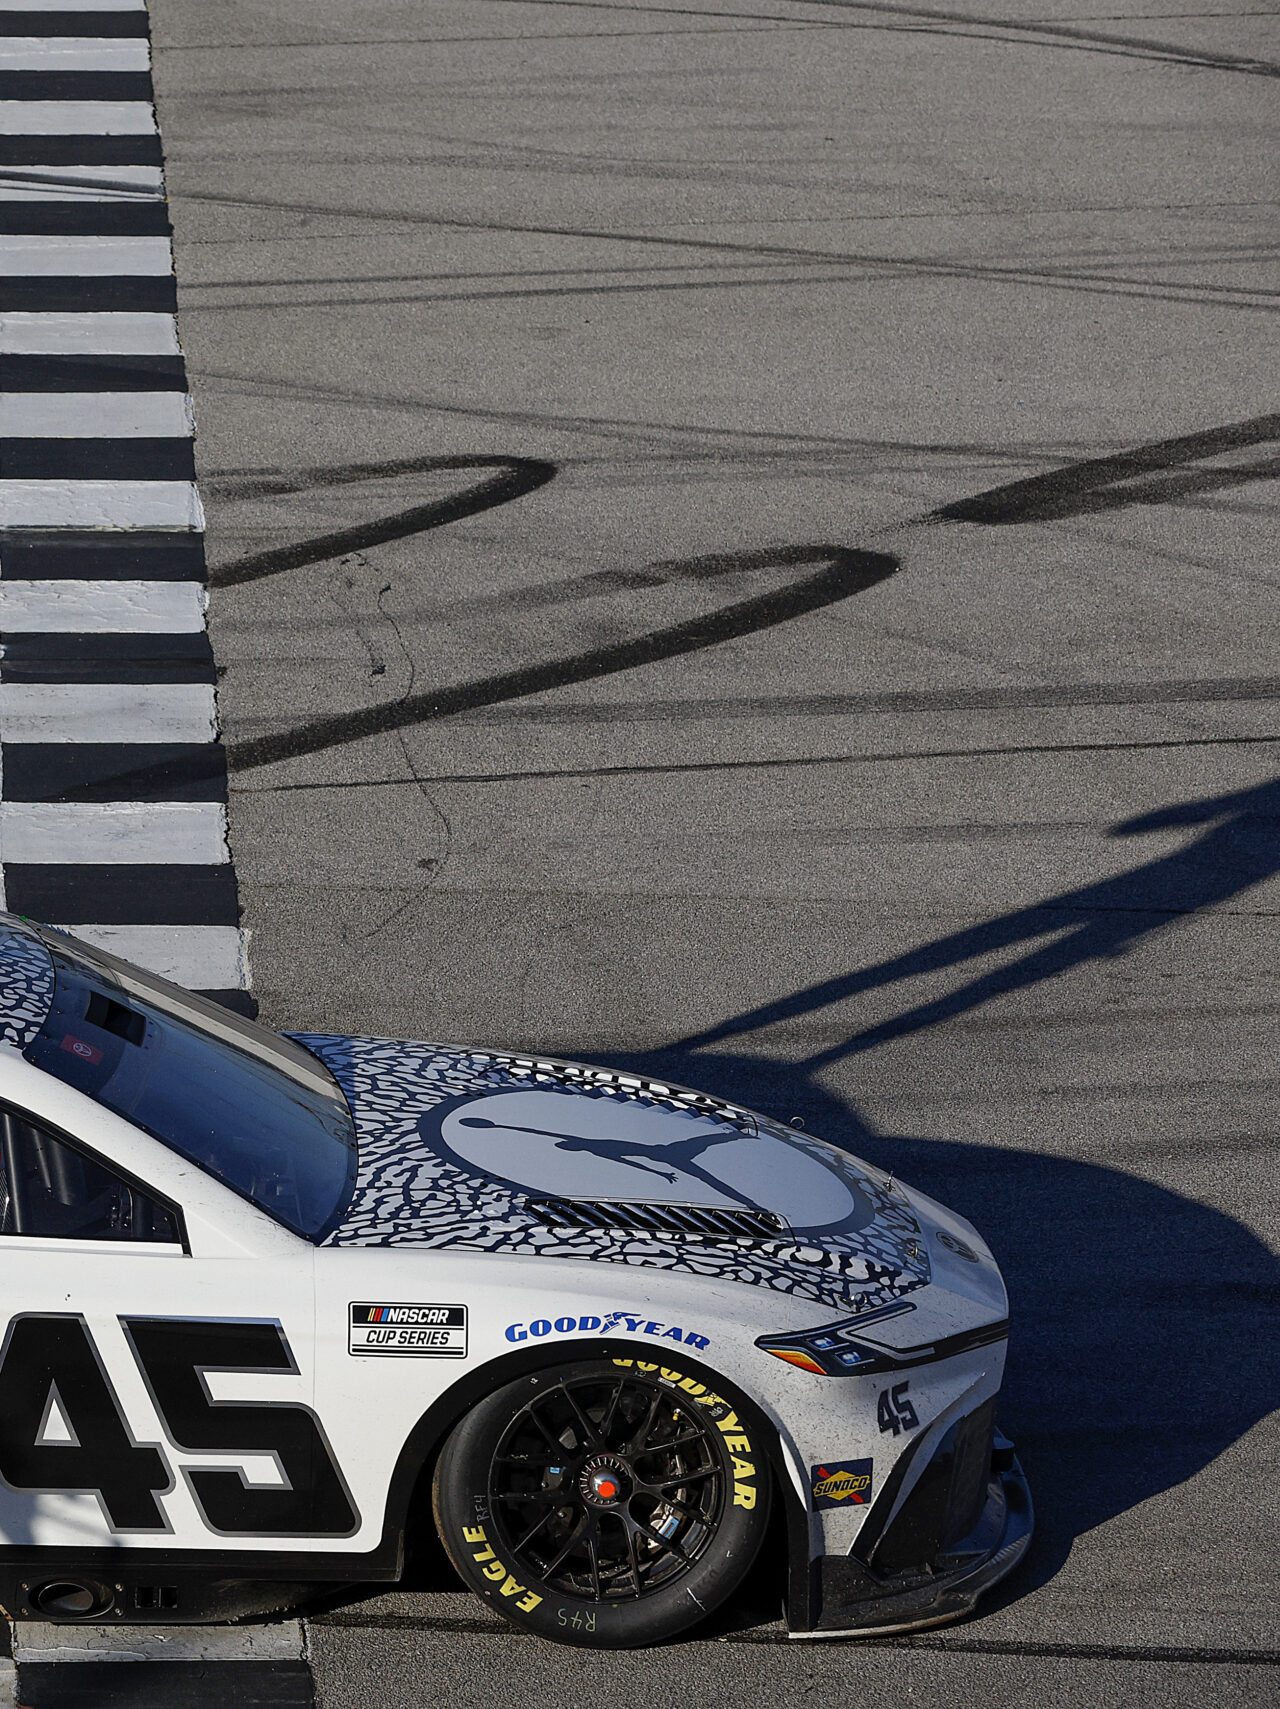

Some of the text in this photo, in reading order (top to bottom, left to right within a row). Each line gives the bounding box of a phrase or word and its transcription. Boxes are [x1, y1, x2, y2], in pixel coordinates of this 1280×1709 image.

[386, 1308, 449, 1324] NASCAR
[366, 1330, 451, 1345] CUP SERIES
[505, 1312, 711, 1351] GOODYEAR
[877, 1380, 920, 1437] 45
[814, 1476, 870, 1496] SUNOCO
[462, 1525, 543, 1613] EAGLE
